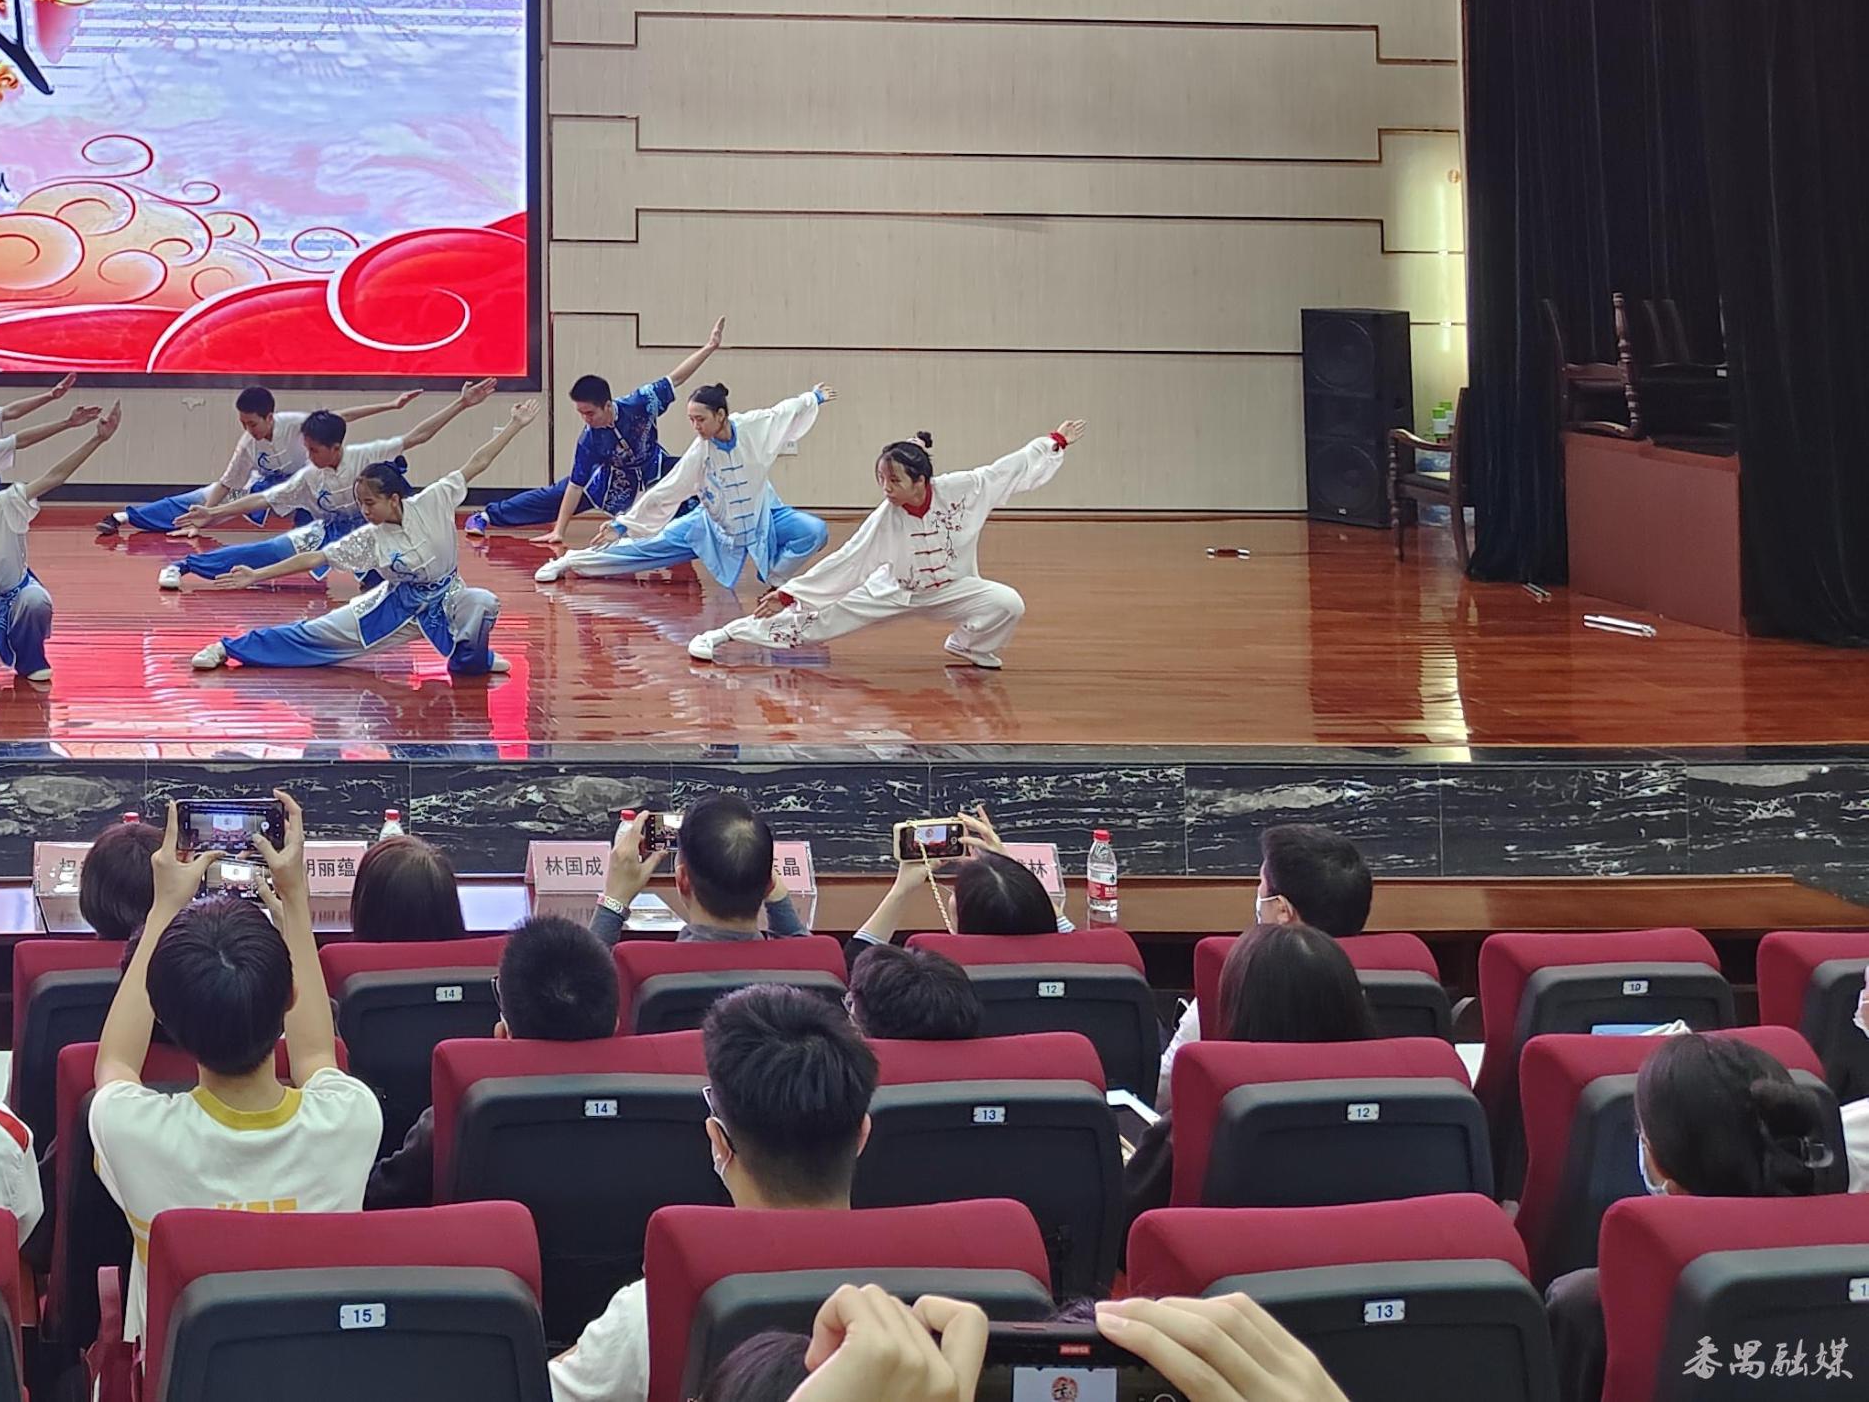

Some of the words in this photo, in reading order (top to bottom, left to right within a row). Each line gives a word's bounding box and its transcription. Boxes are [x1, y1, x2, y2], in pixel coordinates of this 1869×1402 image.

[545, 855, 604, 876] 林国成
[443, 989, 455, 999] 14
[1046, 984, 1057, 994] 12
[594, 1103, 608, 1115] 14
[1357, 1107, 1370, 1118] 12
[983, 1110, 997, 1121] 13
[352, 1309, 372, 1325] 15
[1376, 1304, 1394, 1319] 13
